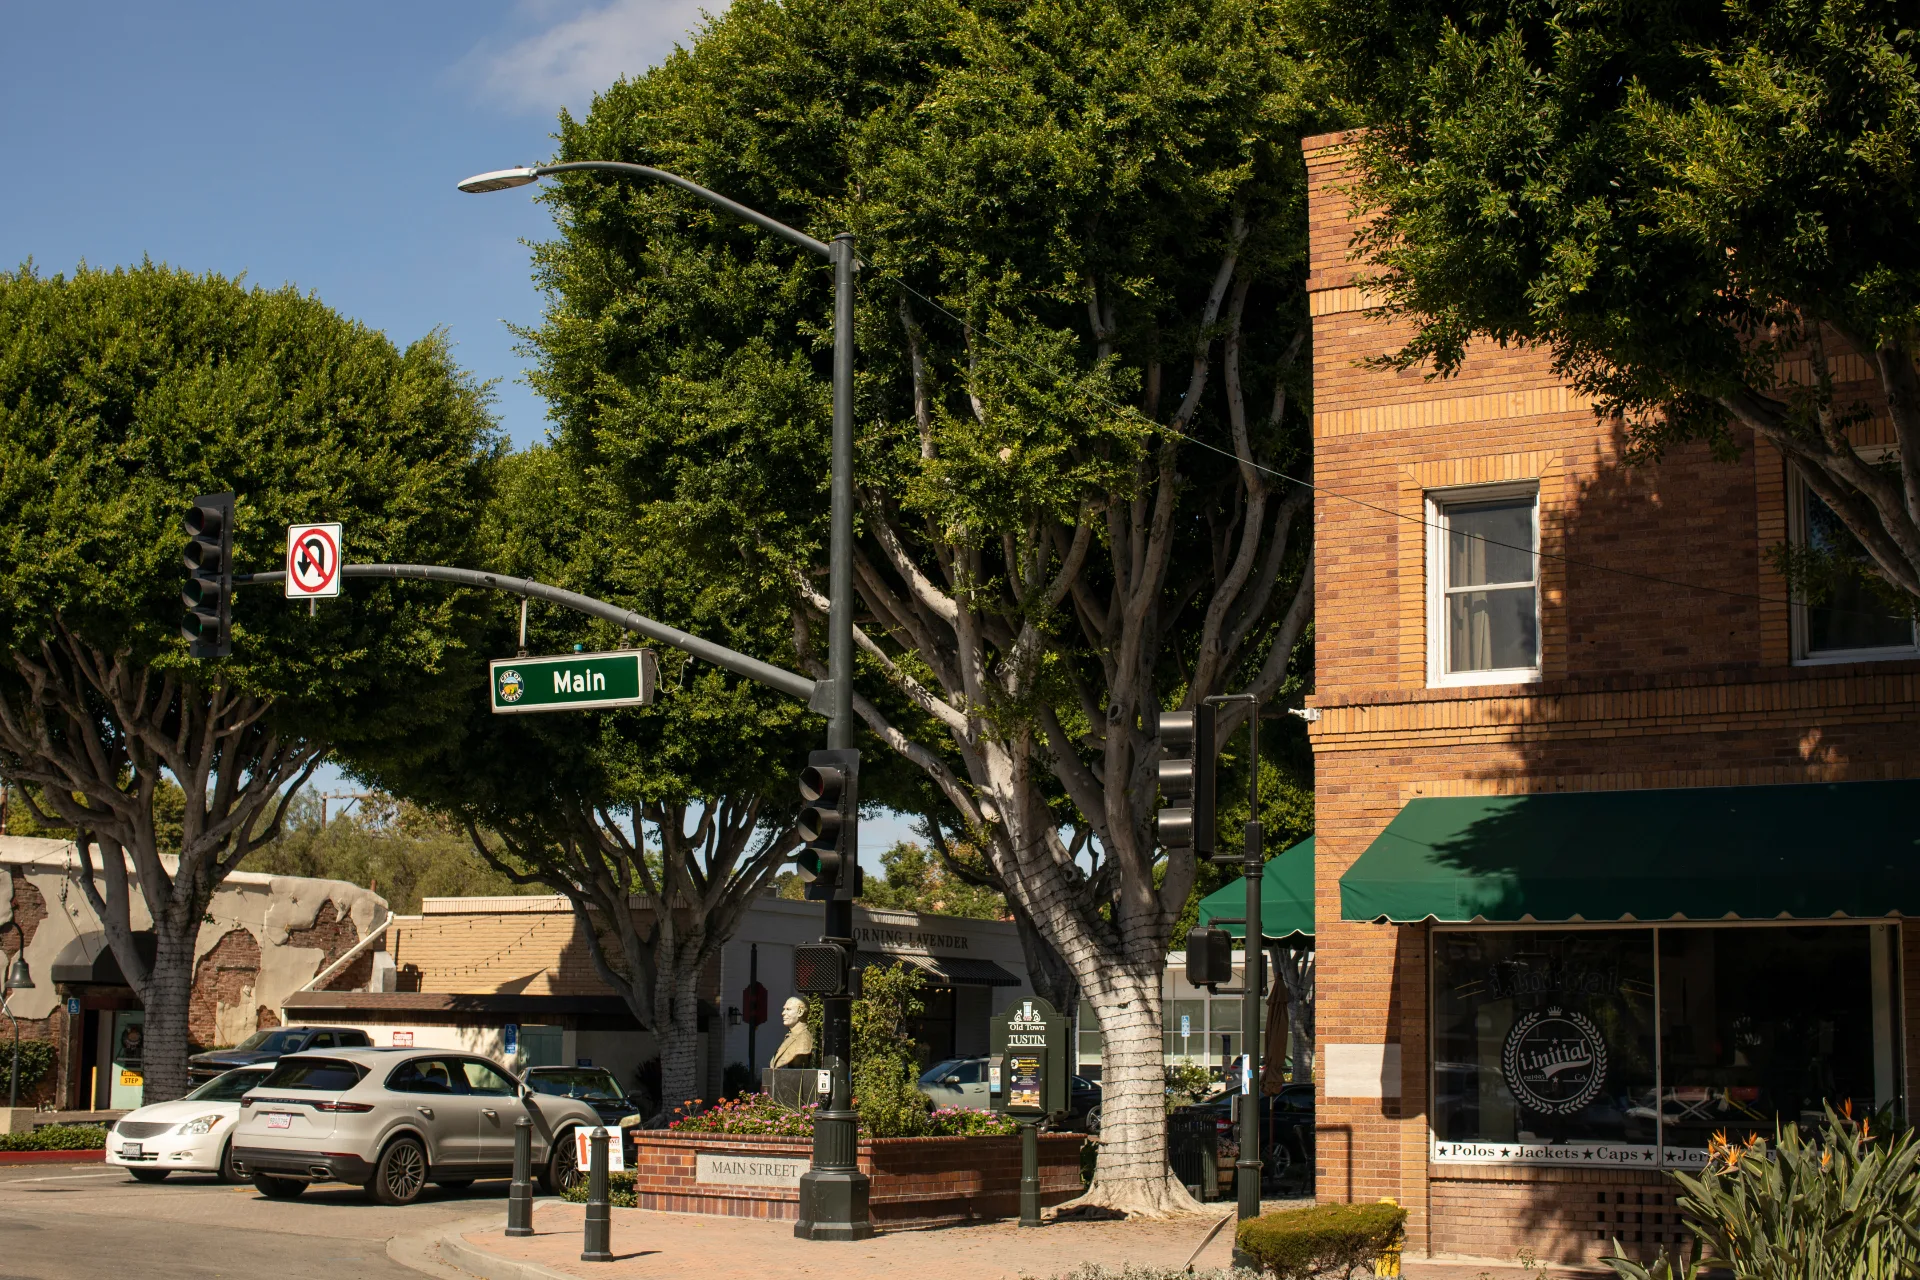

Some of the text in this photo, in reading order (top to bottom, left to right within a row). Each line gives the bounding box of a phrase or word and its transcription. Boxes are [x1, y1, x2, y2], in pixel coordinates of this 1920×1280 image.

[500, 671, 513, 683] CITY
[553, 668, 606, 694] Main
[500, 688, 523, 701] TUSTIN
[853, 928, 969, 949] ORNING LAVENDER
[1009, 1023, 1024, 1031] Old
[1008, 1034, 1046, 1044] TUSTIN
[1520, 1038, 1592, 1071] i.initial
[1452, 1144, 1638, 1163] Polos Jackets Caps
[711, 1161, 798, 1177] MAIN STREET
